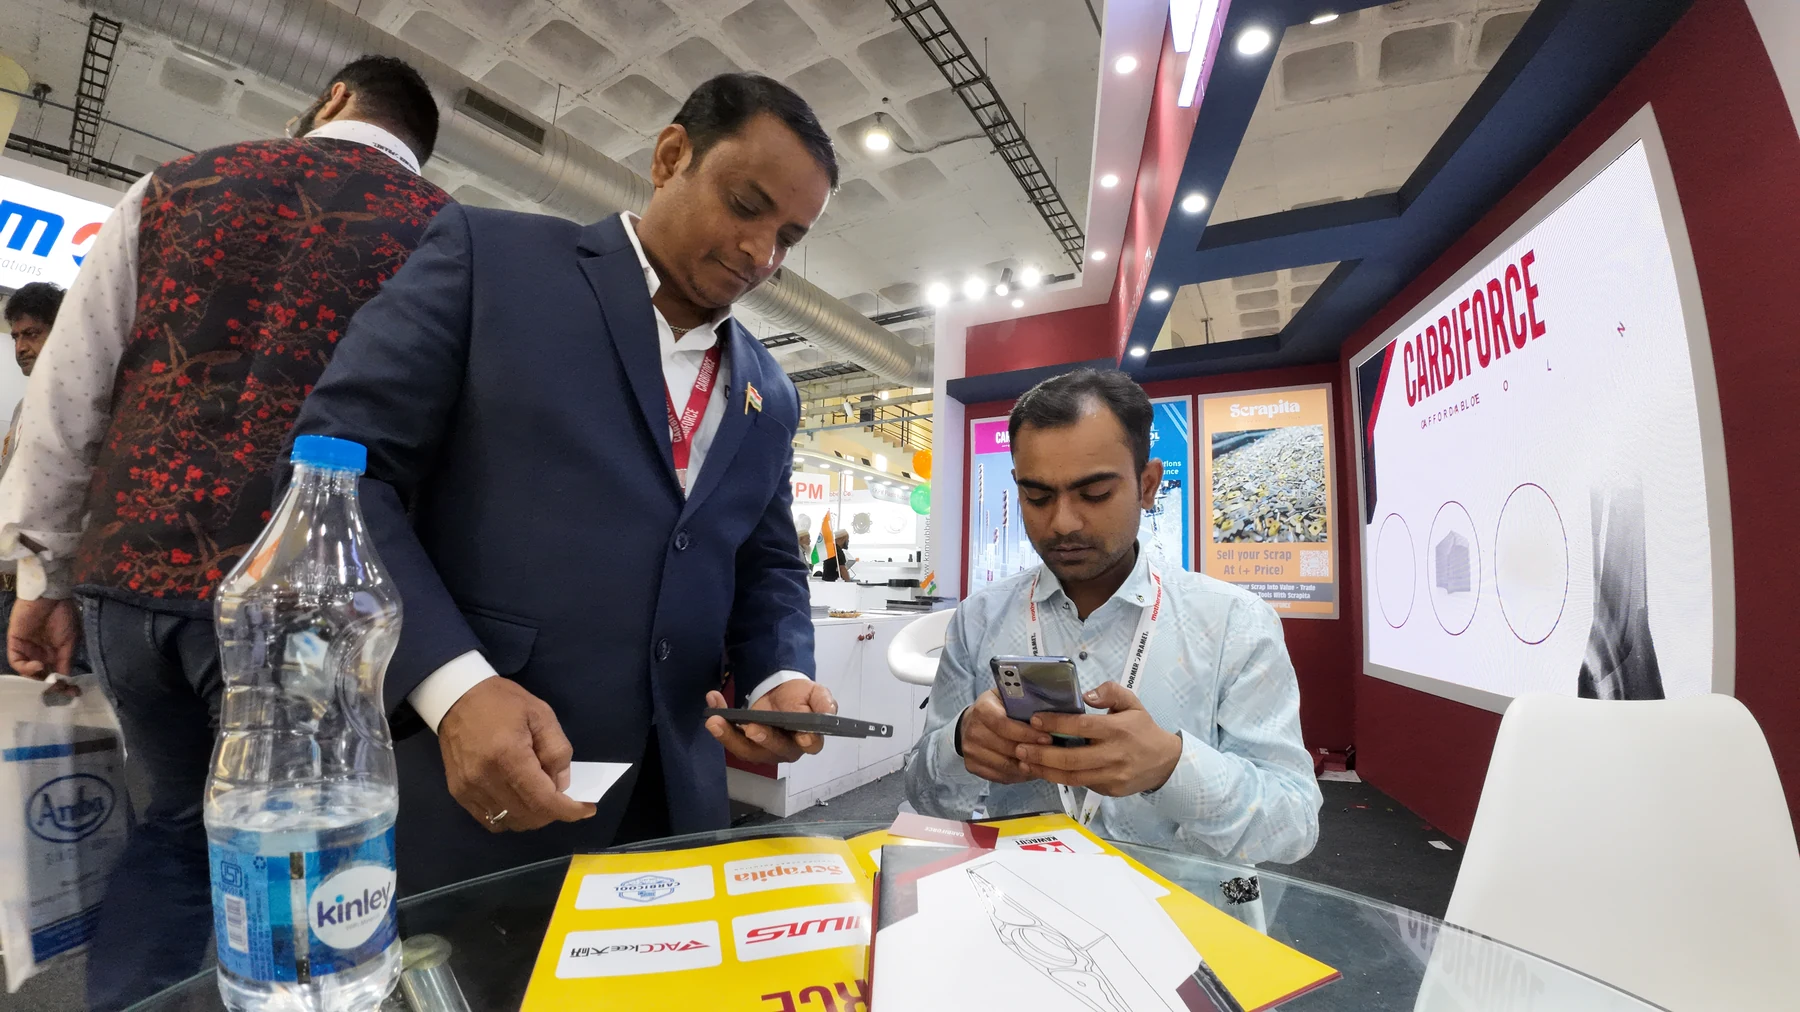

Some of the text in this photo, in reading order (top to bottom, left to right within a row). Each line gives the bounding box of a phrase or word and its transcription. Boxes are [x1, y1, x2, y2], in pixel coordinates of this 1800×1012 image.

[0, 258, 43, 276] ations
[1403, 249, 1546, 408] CARBIFORCE
[695, 356, 716, 393] CARBIFORCE
[1229, 399, 1301, 418] Scrapita
[790, 482, 823, 500] PM
[1216, 550, 1292, 562] Sell your Scrap
[1223, 565, 1235, 575] At
[1254, 565, 1284, 575] Price)
[1287, 592, 1311, 600] Scrapita
[1127, 662, 1139, 689] DORMER
[1015, 835, 1058, 847] KAWACUT
[733, 865, 844, 882] Scrapita
[317, 881, 391, 928] kinley
